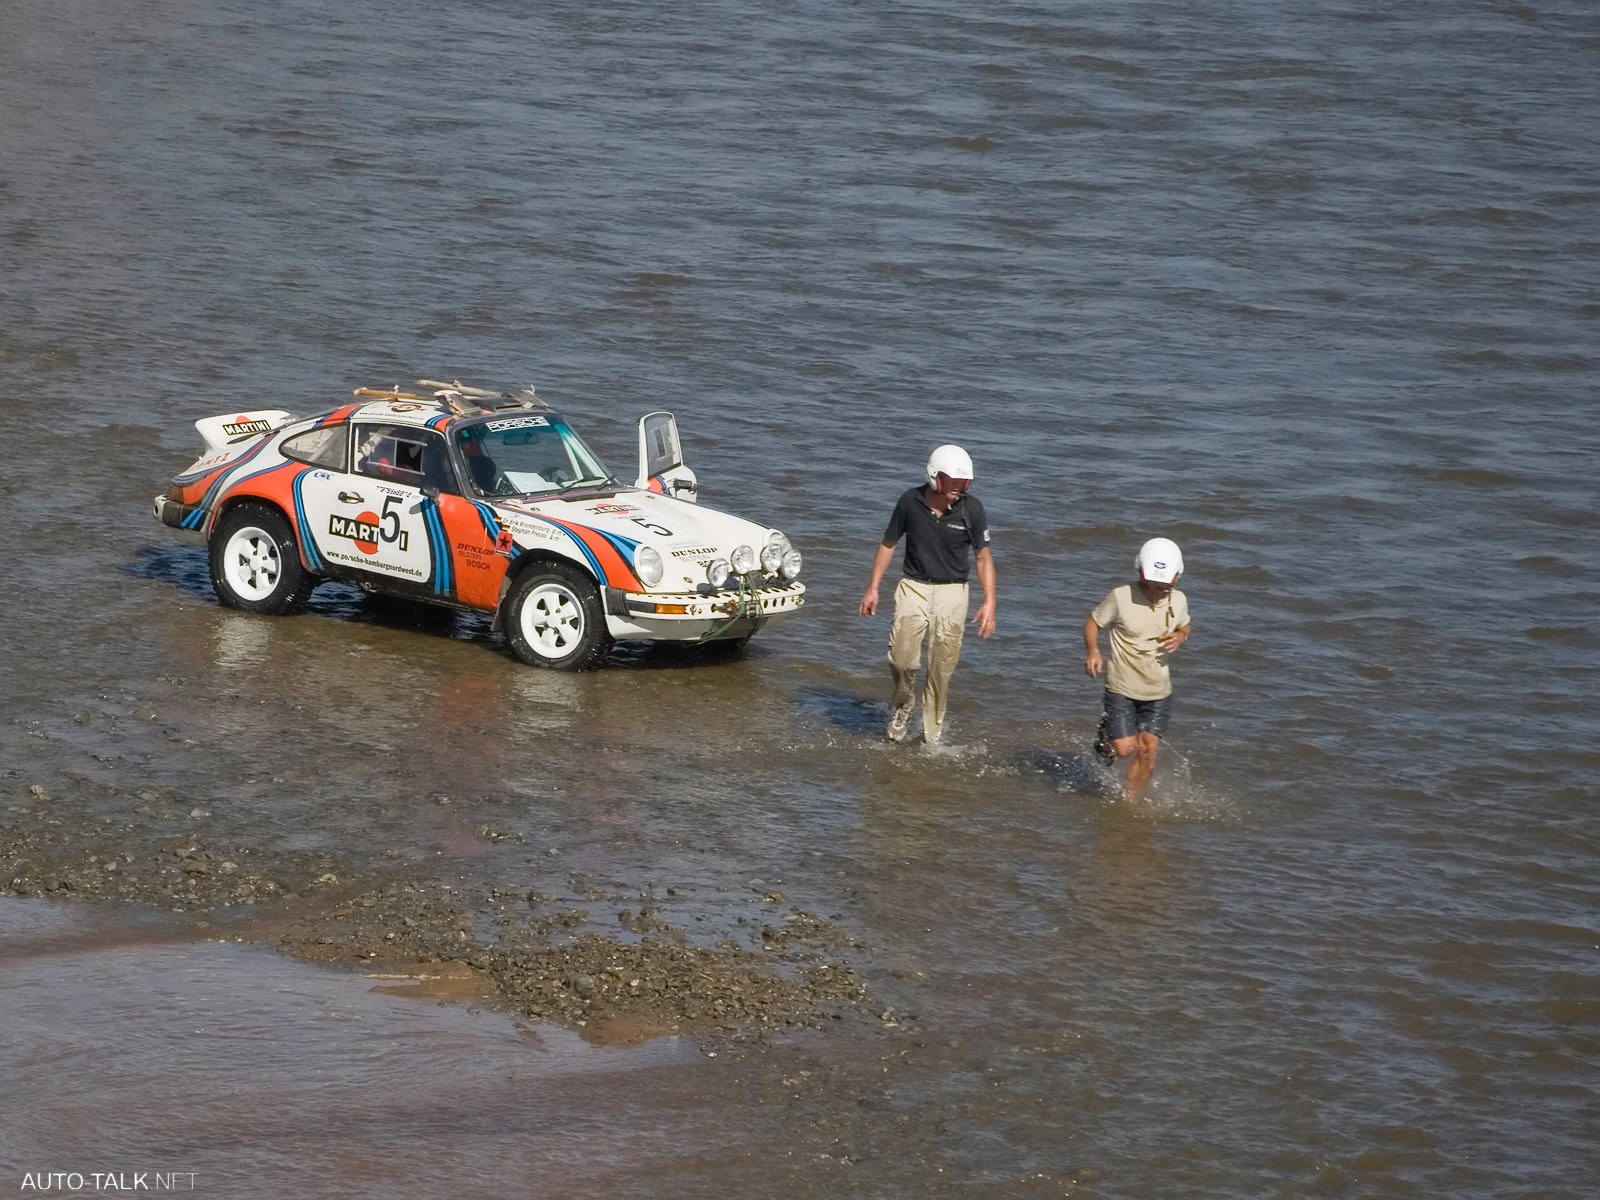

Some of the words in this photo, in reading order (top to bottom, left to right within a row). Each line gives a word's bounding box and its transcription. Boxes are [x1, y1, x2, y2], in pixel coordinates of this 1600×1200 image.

[224, 420, 270, 435] MARTINI
[485, 416, 550, 432] PORSCHE
[380, 495, 403, 543] 5
[631, 518, 673, 536] 5
[457, 543, 496, 556] DUNLOP
[671, 547, 718, 557] DUNLOP
[327, 551, 423, 578] www.porsche-hamburgnordwest.de
[466, 559, 491, 571] BOSCH
